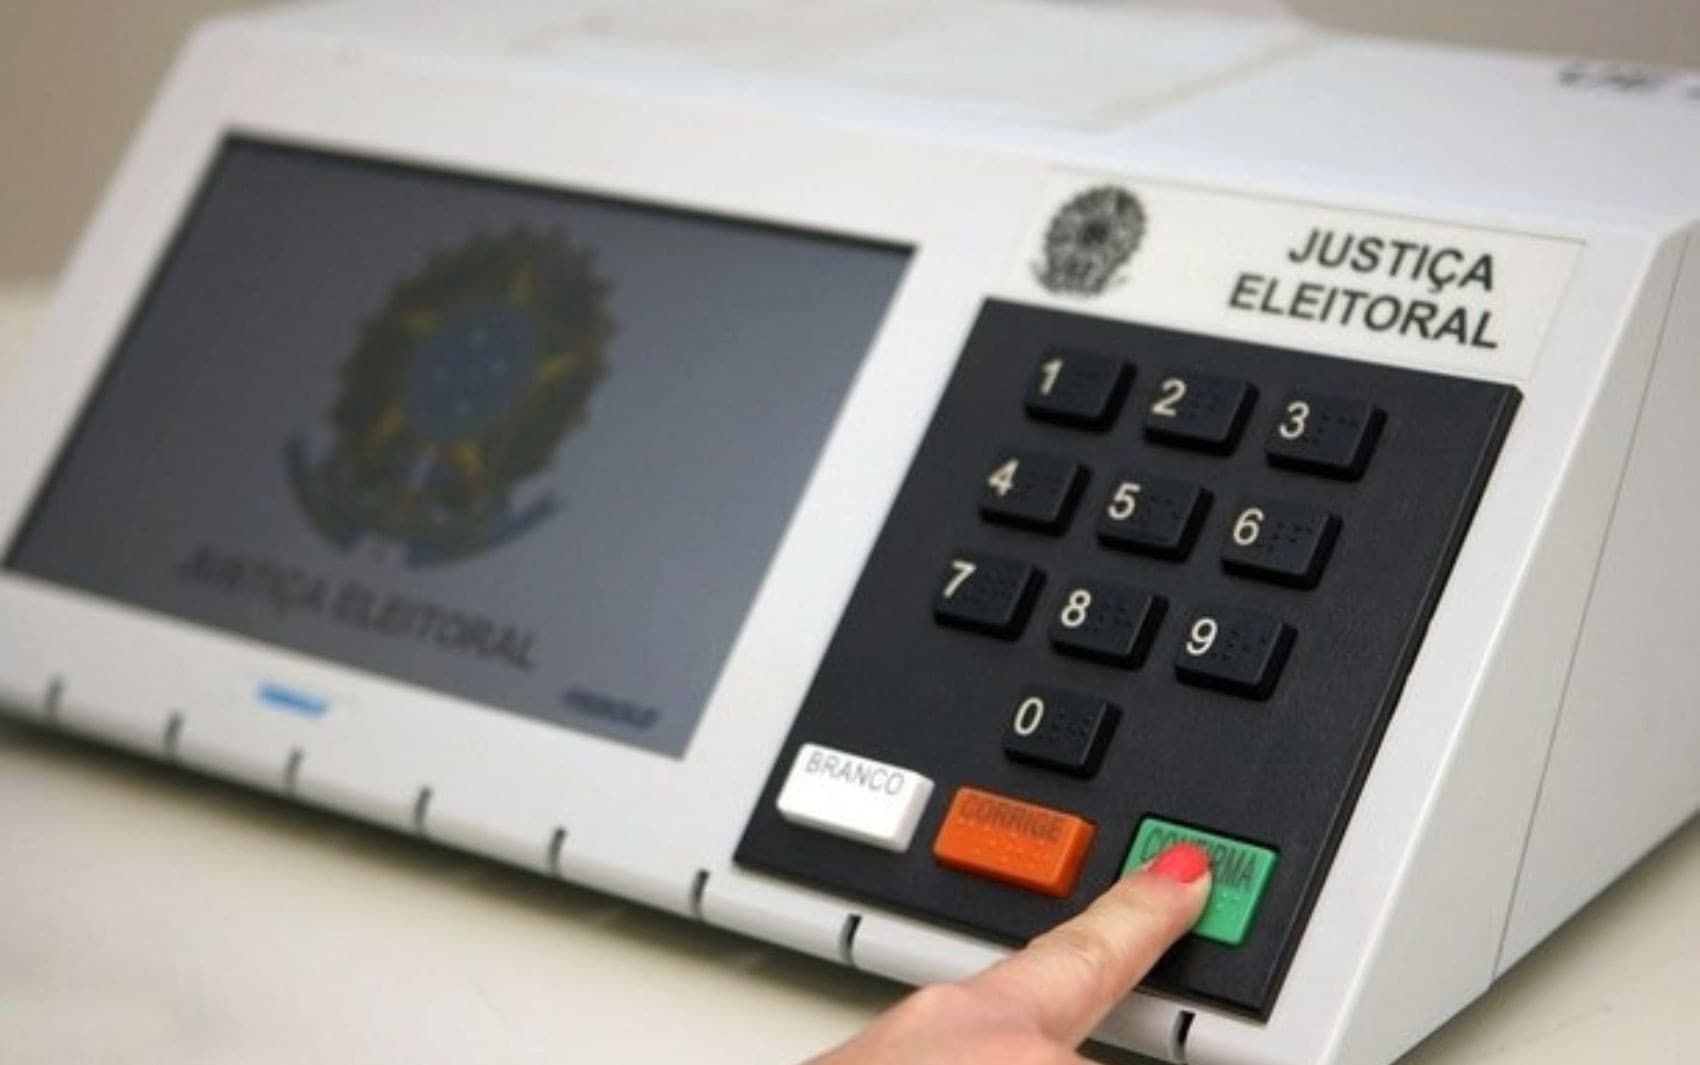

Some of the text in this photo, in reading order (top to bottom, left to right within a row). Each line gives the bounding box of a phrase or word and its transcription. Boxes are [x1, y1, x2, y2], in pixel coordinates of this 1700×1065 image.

[1288, 228, 1494, 292] JUSTIÇA
[1228, 273, 1498, 349] ELEITORAL
[1040, 359, 1064, 396] 1
[1151, 378, 1188, 417] 2
[1278, 400, 1311, 440] 3
[987, 459, 1020, 497] 4
[1106, 481, 1142, 521] 5
[1231, 507, 1265, 547] 6
[942, 560, 977, 599] 7
[1060, 588, 1092, 628] 8
[1185, 617, 1219, 657] 9
[1012, 696, 1045, 737] 0
[804, 750, 905, 796] BRANCO
[959, 796, 1061, 842] CORRIGE
[1139, 826, 1259, 893] CORMA
